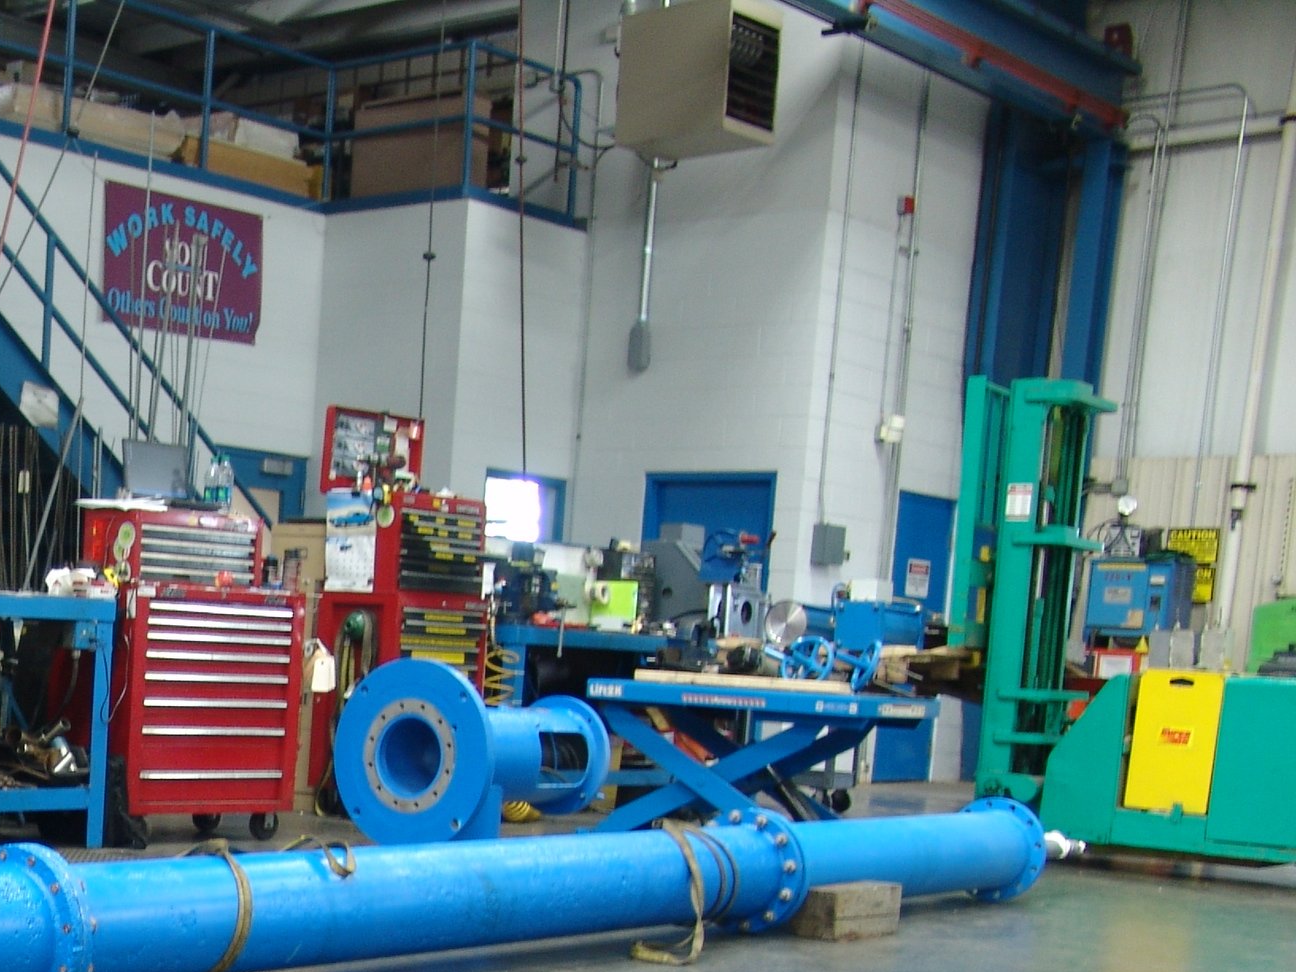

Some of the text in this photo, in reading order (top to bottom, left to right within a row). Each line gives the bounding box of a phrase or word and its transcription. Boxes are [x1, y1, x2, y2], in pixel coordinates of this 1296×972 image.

[106, 203, 258, 279] WORK SAFELY
[147, 259, 219, 301] COUNT
[107, 287, 154, 317] Others
[204, 311, 220, 329] on
[223, 308, 253, 334] You!
[1170, 529, 1217, 541] CAUTION
